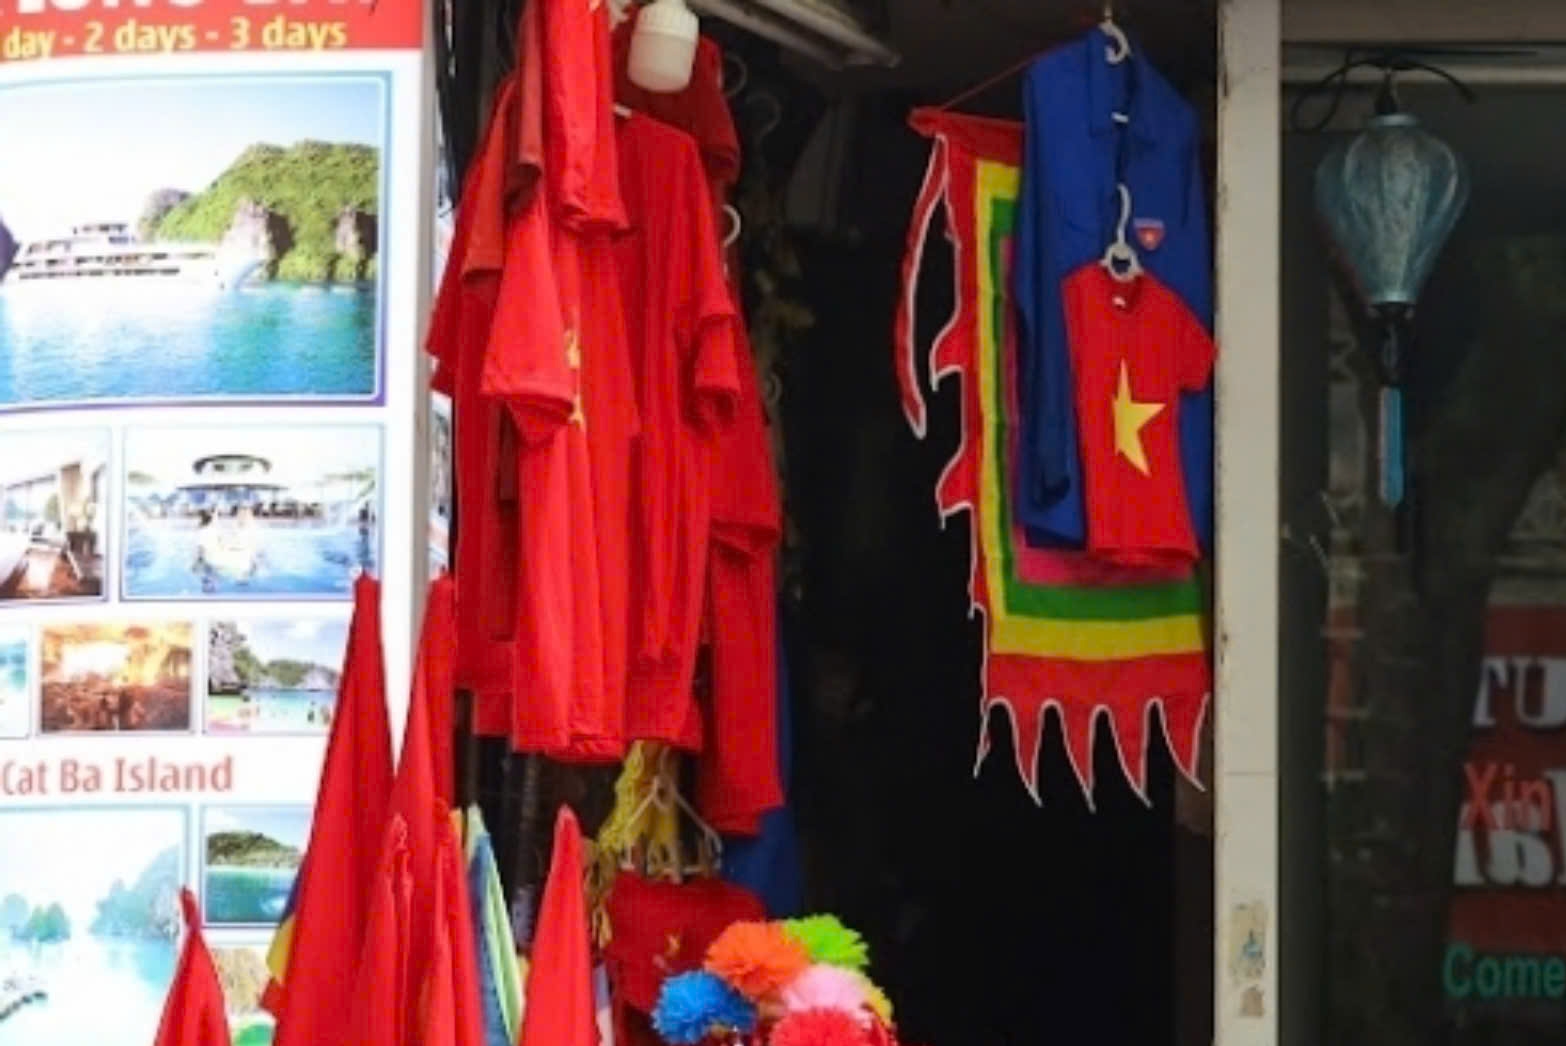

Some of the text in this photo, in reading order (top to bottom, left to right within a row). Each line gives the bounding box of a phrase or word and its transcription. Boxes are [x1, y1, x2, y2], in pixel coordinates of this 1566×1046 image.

[4, 26, 54, 59] day
[84, 22, 103, 51] 2
[114, 18, 197, 53] days
[229, 17, 252, 47] 3
[262, 15, 347, 51] days
[2, 755, 233, 796] Cat Ba Island
[1464, 763, 1549, 831] Xin
[1443, 943, 1566, 998] Come
